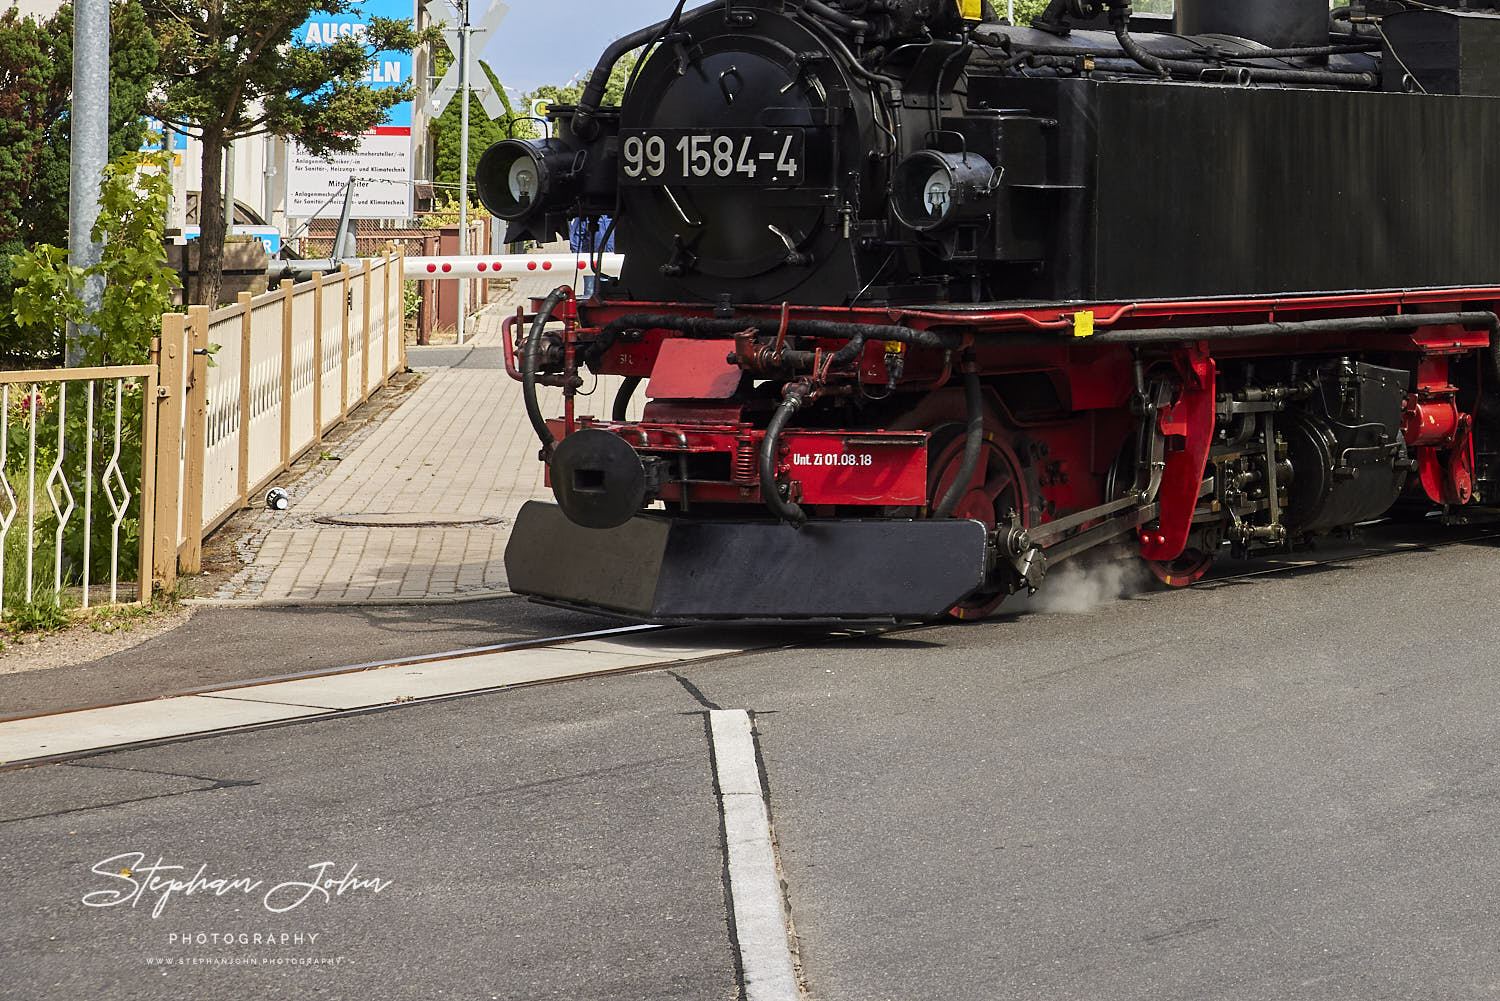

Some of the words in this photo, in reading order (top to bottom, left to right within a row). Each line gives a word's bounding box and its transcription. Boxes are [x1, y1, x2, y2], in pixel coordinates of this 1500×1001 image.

[624, 136, 665, 177] 99
[676, 135, 797, 178] 1584-4
[328, 180, 369, 188] Mitaeiter
[794, 453, 812, 466] Unt.
[814, 453, 823, 466] Zi
[825, 453, 872, 466] 01.08.18
